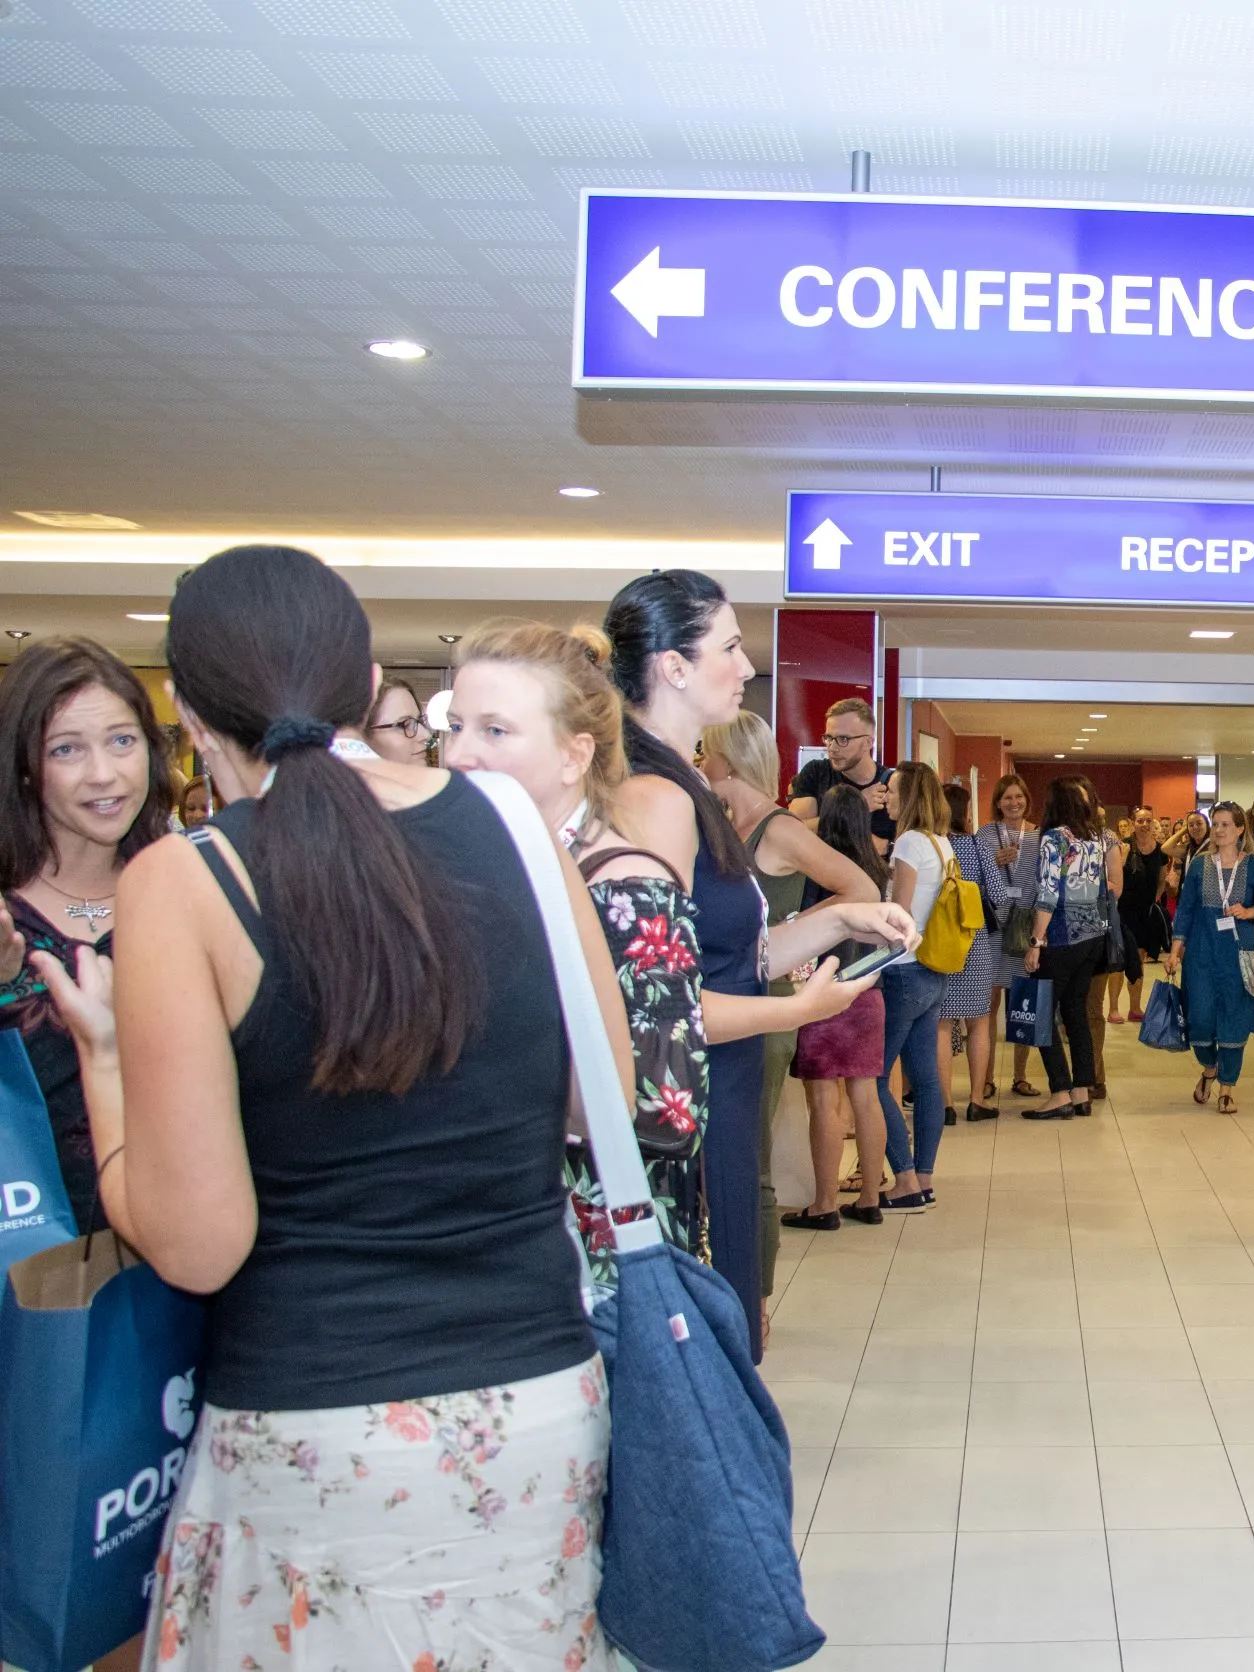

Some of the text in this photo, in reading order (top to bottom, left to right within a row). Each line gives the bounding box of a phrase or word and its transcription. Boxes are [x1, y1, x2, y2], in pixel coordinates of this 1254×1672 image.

[883, 531, 980, 568] EXIT
[1011, 1010, 1036, 1021] POROD
[95, 1447, 185, 1542] POR
